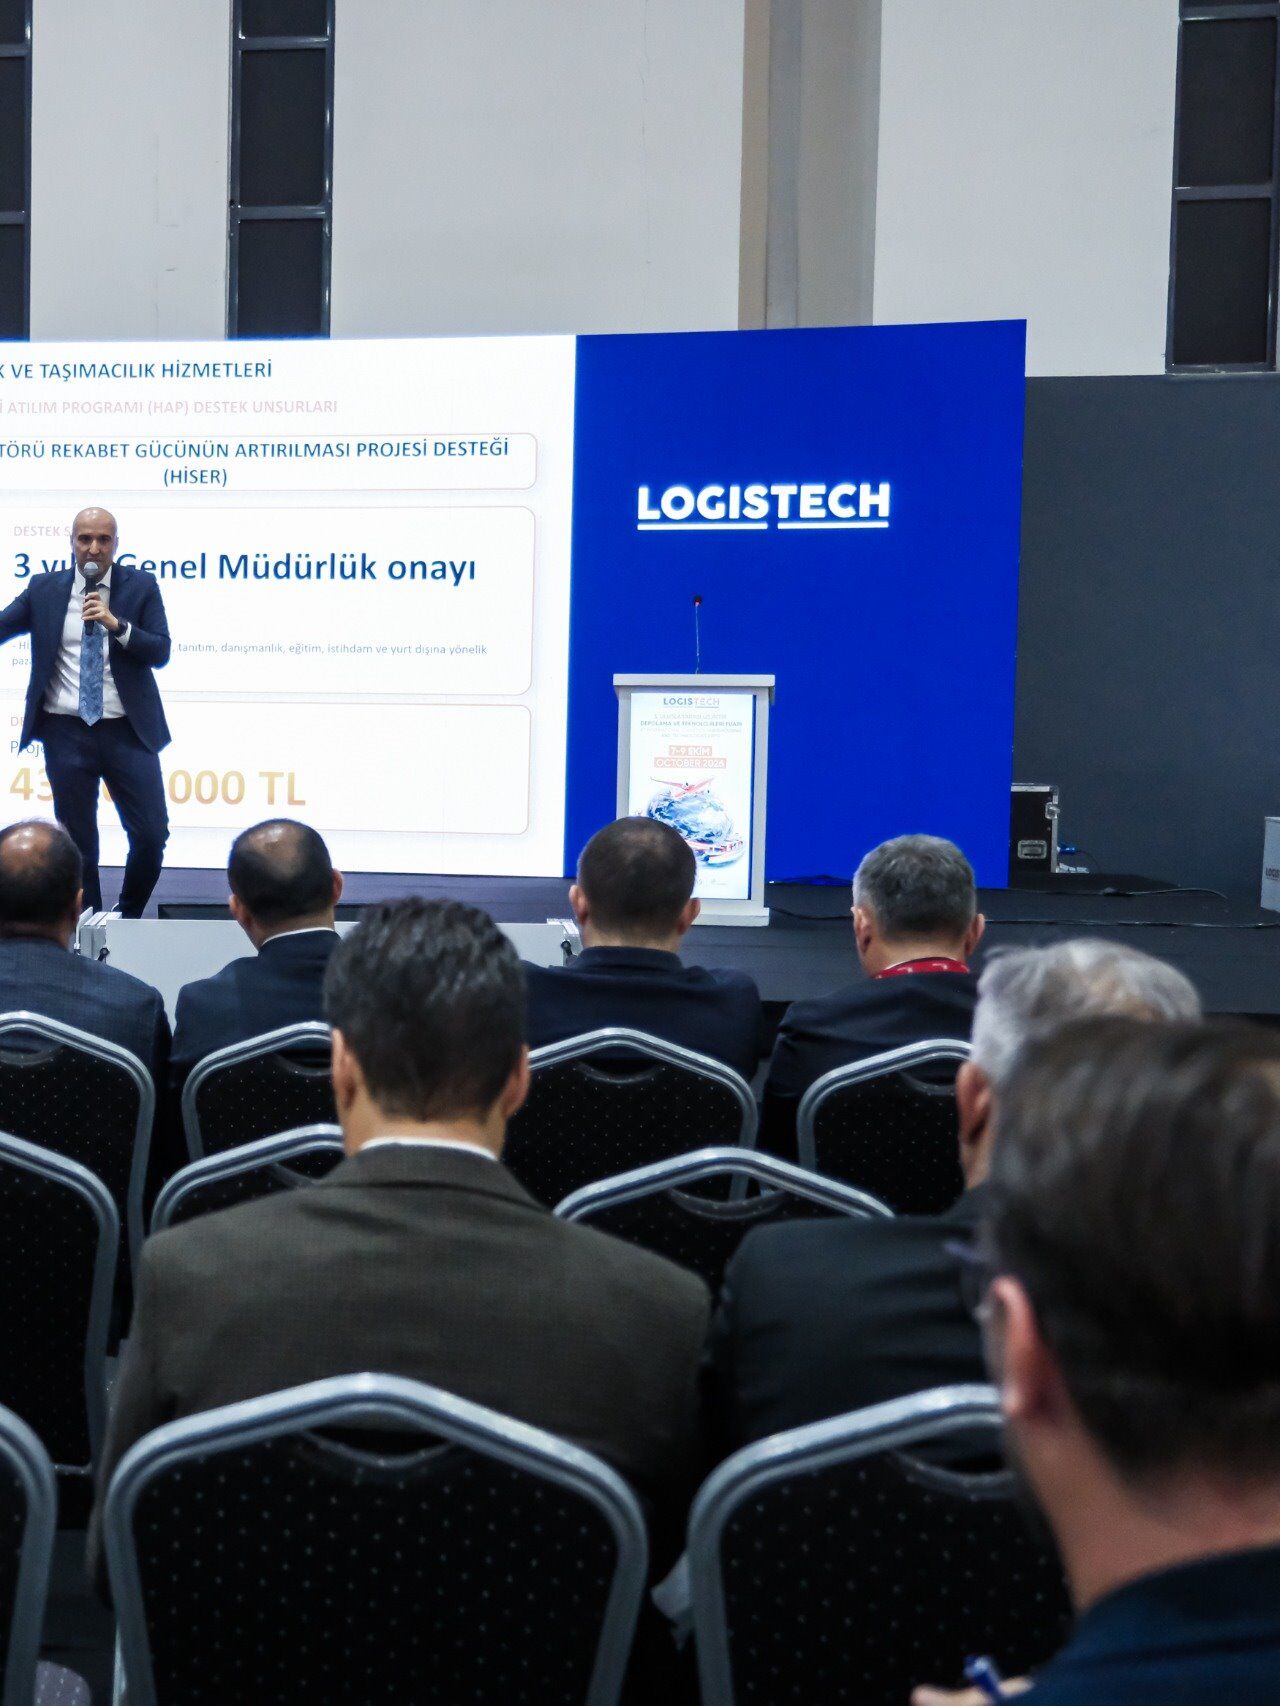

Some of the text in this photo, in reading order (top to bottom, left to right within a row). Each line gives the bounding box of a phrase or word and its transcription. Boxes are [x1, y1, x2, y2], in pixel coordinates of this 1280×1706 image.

[10, 363, 33, 379] VE
[39, 363, 155, 383] TAŞIMACILIK
[161, 358, 272, 378] HİZMETLERİ
[6, 401, 57, 415] ATILIM
[62, 401, 143, 415] PROGRAMI
[147, 400, 189, 417] (HAP)
[193, 399, 248, 414] DESTEK
[252, 400, 338, 414] UNSURLARI
[52, 443, 131, 458] REKABET
[135, 439, 229, 459] GÜCÜNÜN
[234, 442, 350, 458] ARTIRILMASI
[356, 438, 427, 458] PROJESİ
[433, 436, 508, 457] DESTEĞİ
[163, 465, 228, 488] (HİSER)
[637, 483, 890, 520] LOGISTECH
[13, 525, 61, 537] DESTEK
[14, 552, 31, 579] 3
[218, 552, 377, 580] Müdürlük
[387, 560, 475, 587] onayı
[178, 642, 488, 656] tanıtım, danışmanlık, eğitim, istihdam ve yurt dışına yönelik
[656, 759, 701, 768] OCTOBER
[258, 771, 307, 806] TL
